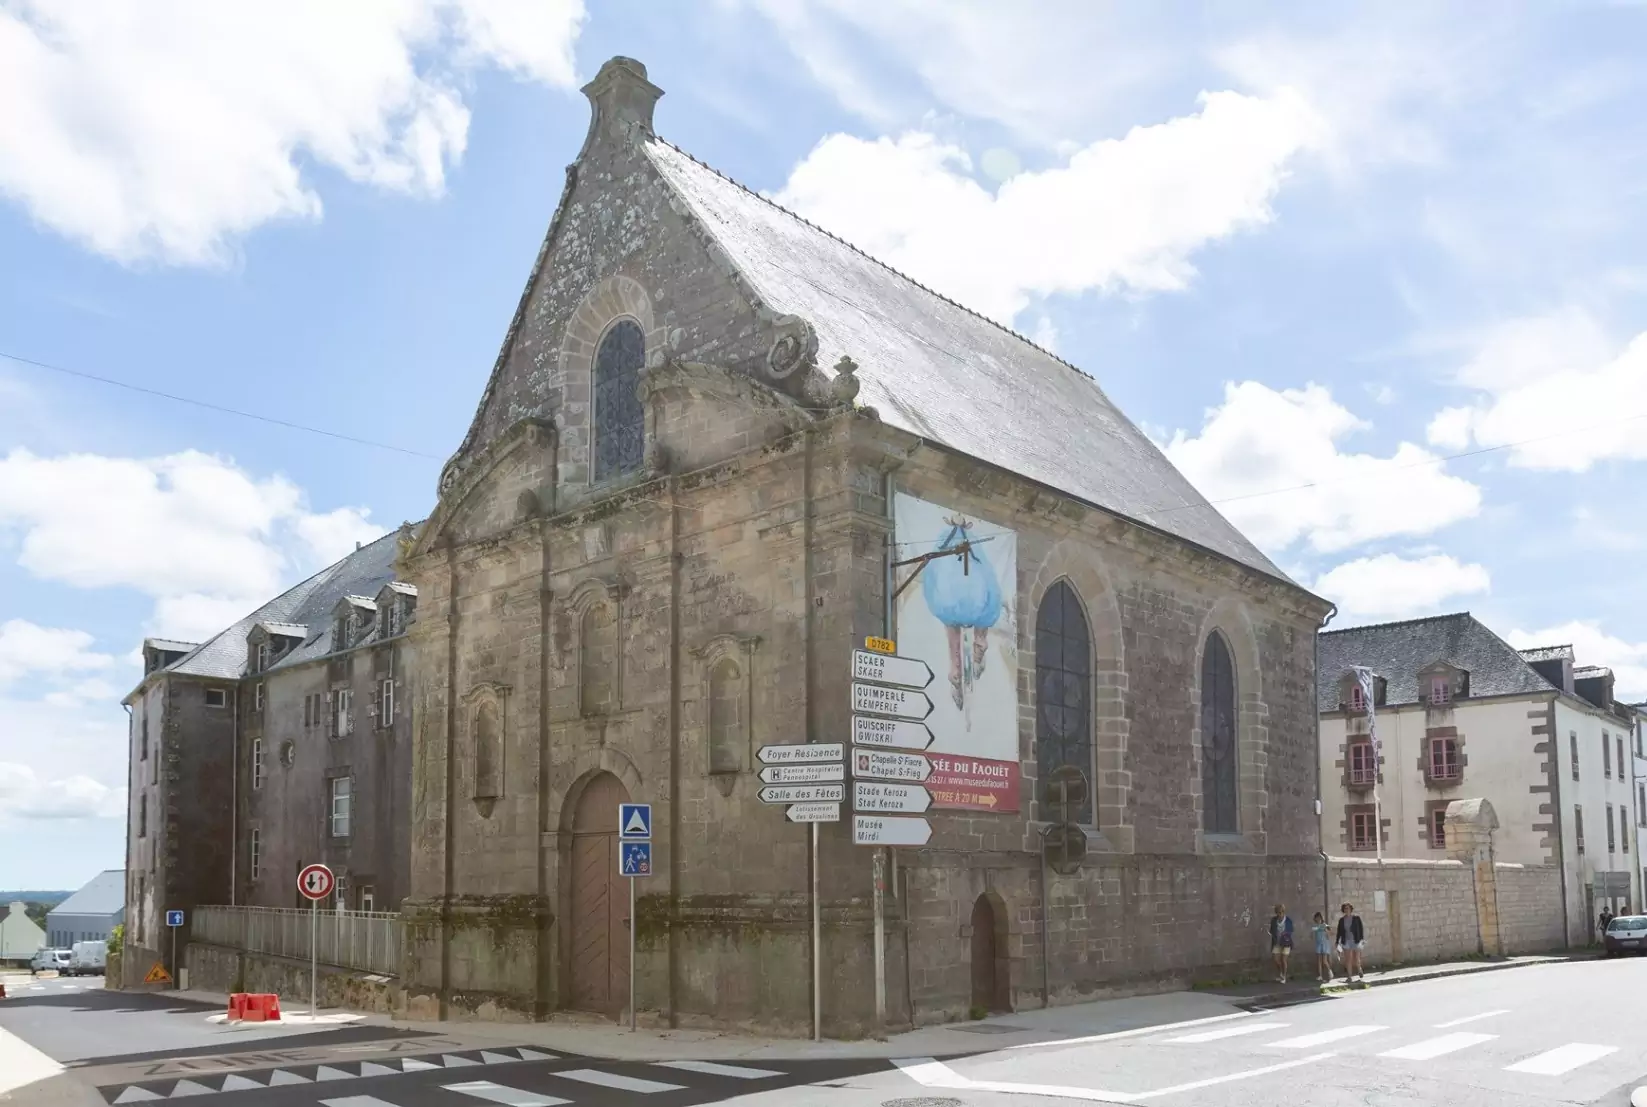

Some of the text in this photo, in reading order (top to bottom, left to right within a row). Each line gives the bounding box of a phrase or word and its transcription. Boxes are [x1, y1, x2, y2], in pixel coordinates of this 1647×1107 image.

[871, 639, 890, 651] D782
[857, 666, 883, 679] SKAER
[857, 687, 906, 702] QUIMPERLÉ
[857, 699, 898, 712] KEMPERLE
[857, 720, 896, 732] GUISCRIFF
[858, 731, 893, 743] GWISKRI
[767, 748, 840, 760] Foyer Résidence
[871, 753, 897, 765] Chapelle
[904, 756, 922, 767] Fiacre
[871, 765, 896, 777] Chapel
[932, 758, 951, 771] SÉE
[954, 762, 969, 773] DU
[772, 769, 780, 779] H
[768, 790, 791, 799] Salle
[795, 789, 811, 799] des
[858, 785, 908, 797] Stade Keroza
[858, 798, 876, 808] Stad
[962, 793, 970, 803] 20
[857, 819, 883, 829] Musée
[857, 831, 880, 841] Mirdi
